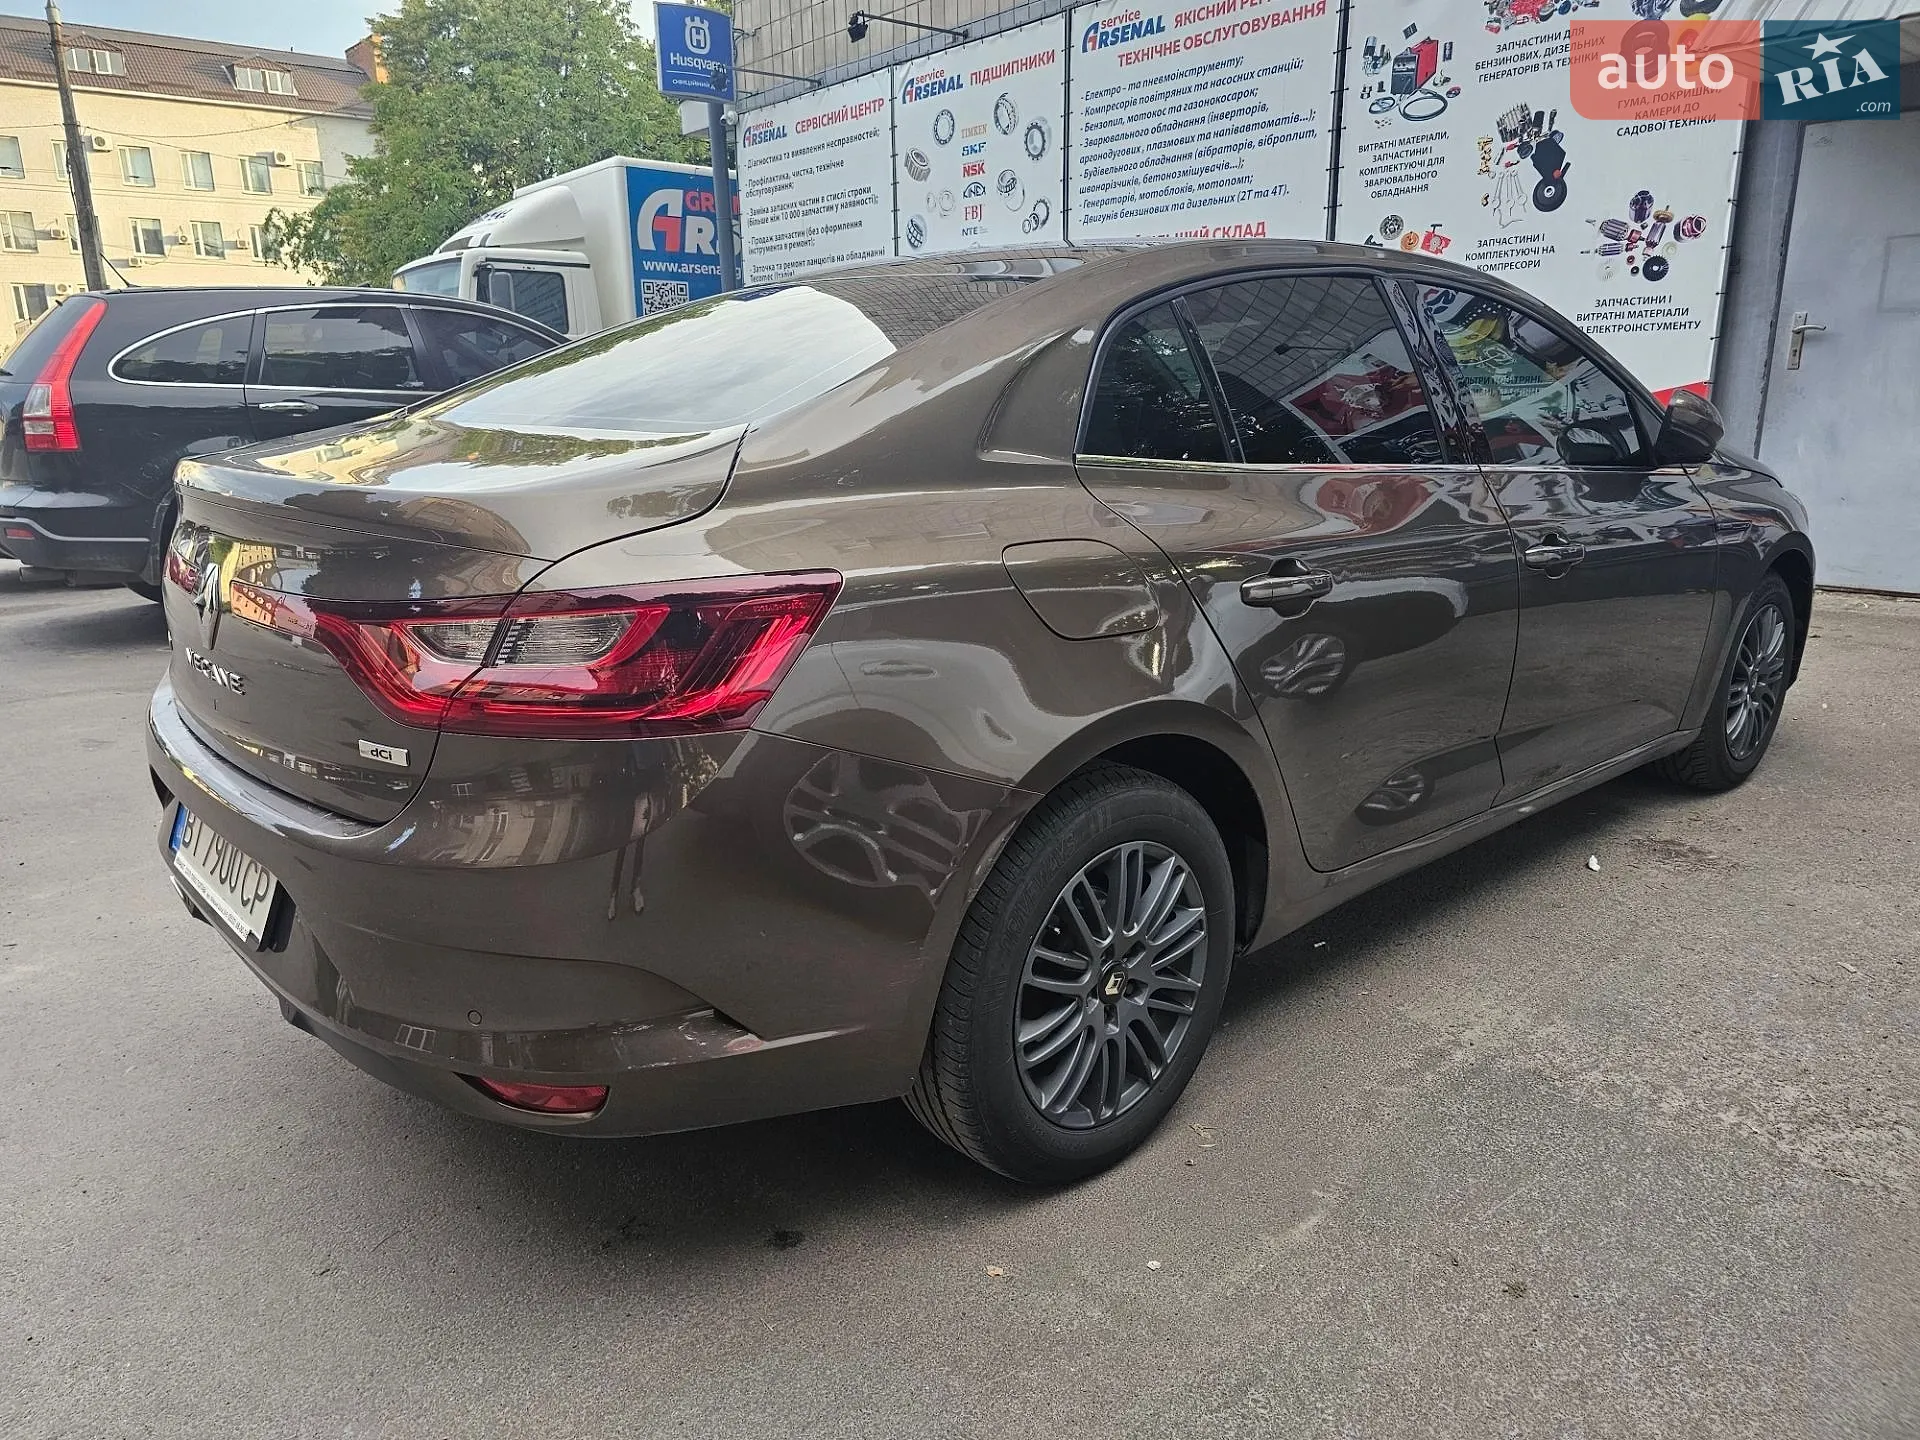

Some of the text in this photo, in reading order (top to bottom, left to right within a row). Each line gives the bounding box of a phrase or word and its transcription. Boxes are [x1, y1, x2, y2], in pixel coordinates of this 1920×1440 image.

[1100, 9, 1141, 30] service
[1081, 15, 1165, 53] ARSENAL
[1118, 0, 1327, 68] ТЕХНІЧНЕ ОБСЛУГОВУВАННЯ
[1495, 26, 1585, 54] ЗАПЧАСТИНИ ДЛЯ
[1475, 36, 1606, 71] БЕНЗИНОВИХ, ДИЗЕЛЬНИХ
[915, 68, 946, 85] service
[970, 49, 1056, 88] ПІДШИПНИКИ
[1478, 51, 1600, 84] ГЕНЕРАТОРІВ ТА ТЕХНІКИ
[902, 74, 964, 104] ARSENAL
[1084, 57, 1304, 117] Компресорів повітряних та насосних станцій;
[1085, 56, 1244, 102] Електро та пневмоінструменту;
[795, 98, 885, 134] СЕРВІСНИЙ ЦЕНТР
[1084, 87, 1259, 133] Бензопил, мотокос та газонокосарок;
[1634, 101, 1701, 121] КАМЕРИ ДО
[752, 119, 774, 132] service
[1084, 126, 1149, 148] Зварювального
[1150, 115, 1206, 135] обладнання
[1616, 113, 1717, 137] САДОВОЇ ТЕХНІКИ
[743, 125, 788, 148] ARSENAL
[1146, 134, 1196, 152] плазмових
[1196, 130, 1211, 142] та
[1358, 130, 1450, 154] ВИТРАТНІ МАТЕРІАЛИ,
[961, 141, 987, 157] SKF
[1083, 161, 1138, 180] Будівельного
[1139, 150, 1193, 169] обладнання
[1257, 127, 1318, 147] віброплит,
[1372, 147, 1429, 163] ЗАПЧАСТИНИ
[962, 161, 986, 178] NSK
[1359, 156, 1446, 177] КОМПЛЕКТУЮЧІ ДЛЯ
[1196, 174, 1254, 192] мотопомп;
[1364, 170, 1439, 188] ЗВАРЮВАЛЬНОГО
[1370, 183, 1430, 199] ОБЛАДНАННЯ
[964, 203, 984, 222] FBJ
[1083, 210, 1119, 226] Двигунів
[1119, 203, 1170, 219] бензинових
[1170, 201, 1185, 212] та
[1186, 193, 1236, 209] дизельних
[1254, 188, 1269, 199] та
[1477, 233, 1540, 248] ЗАПЧАСТИНИ
[1465, 245, 1555, 262] КОМПЛЕКТУЮЧІ НА
[1477, 259, 1541, 272] КОМПРЕСОРИ
[1594, 294, 1667, 308] ЗАПЧАСТИНИ
[1576, 307, 1689, 322] ВИТРАТНІ МАТЕРІАЛИ
[1586, 320, 1702, 334] ЕЛЕКТРОІНСТУМЕНТУ
[370, 748, 392, 761] dCi
